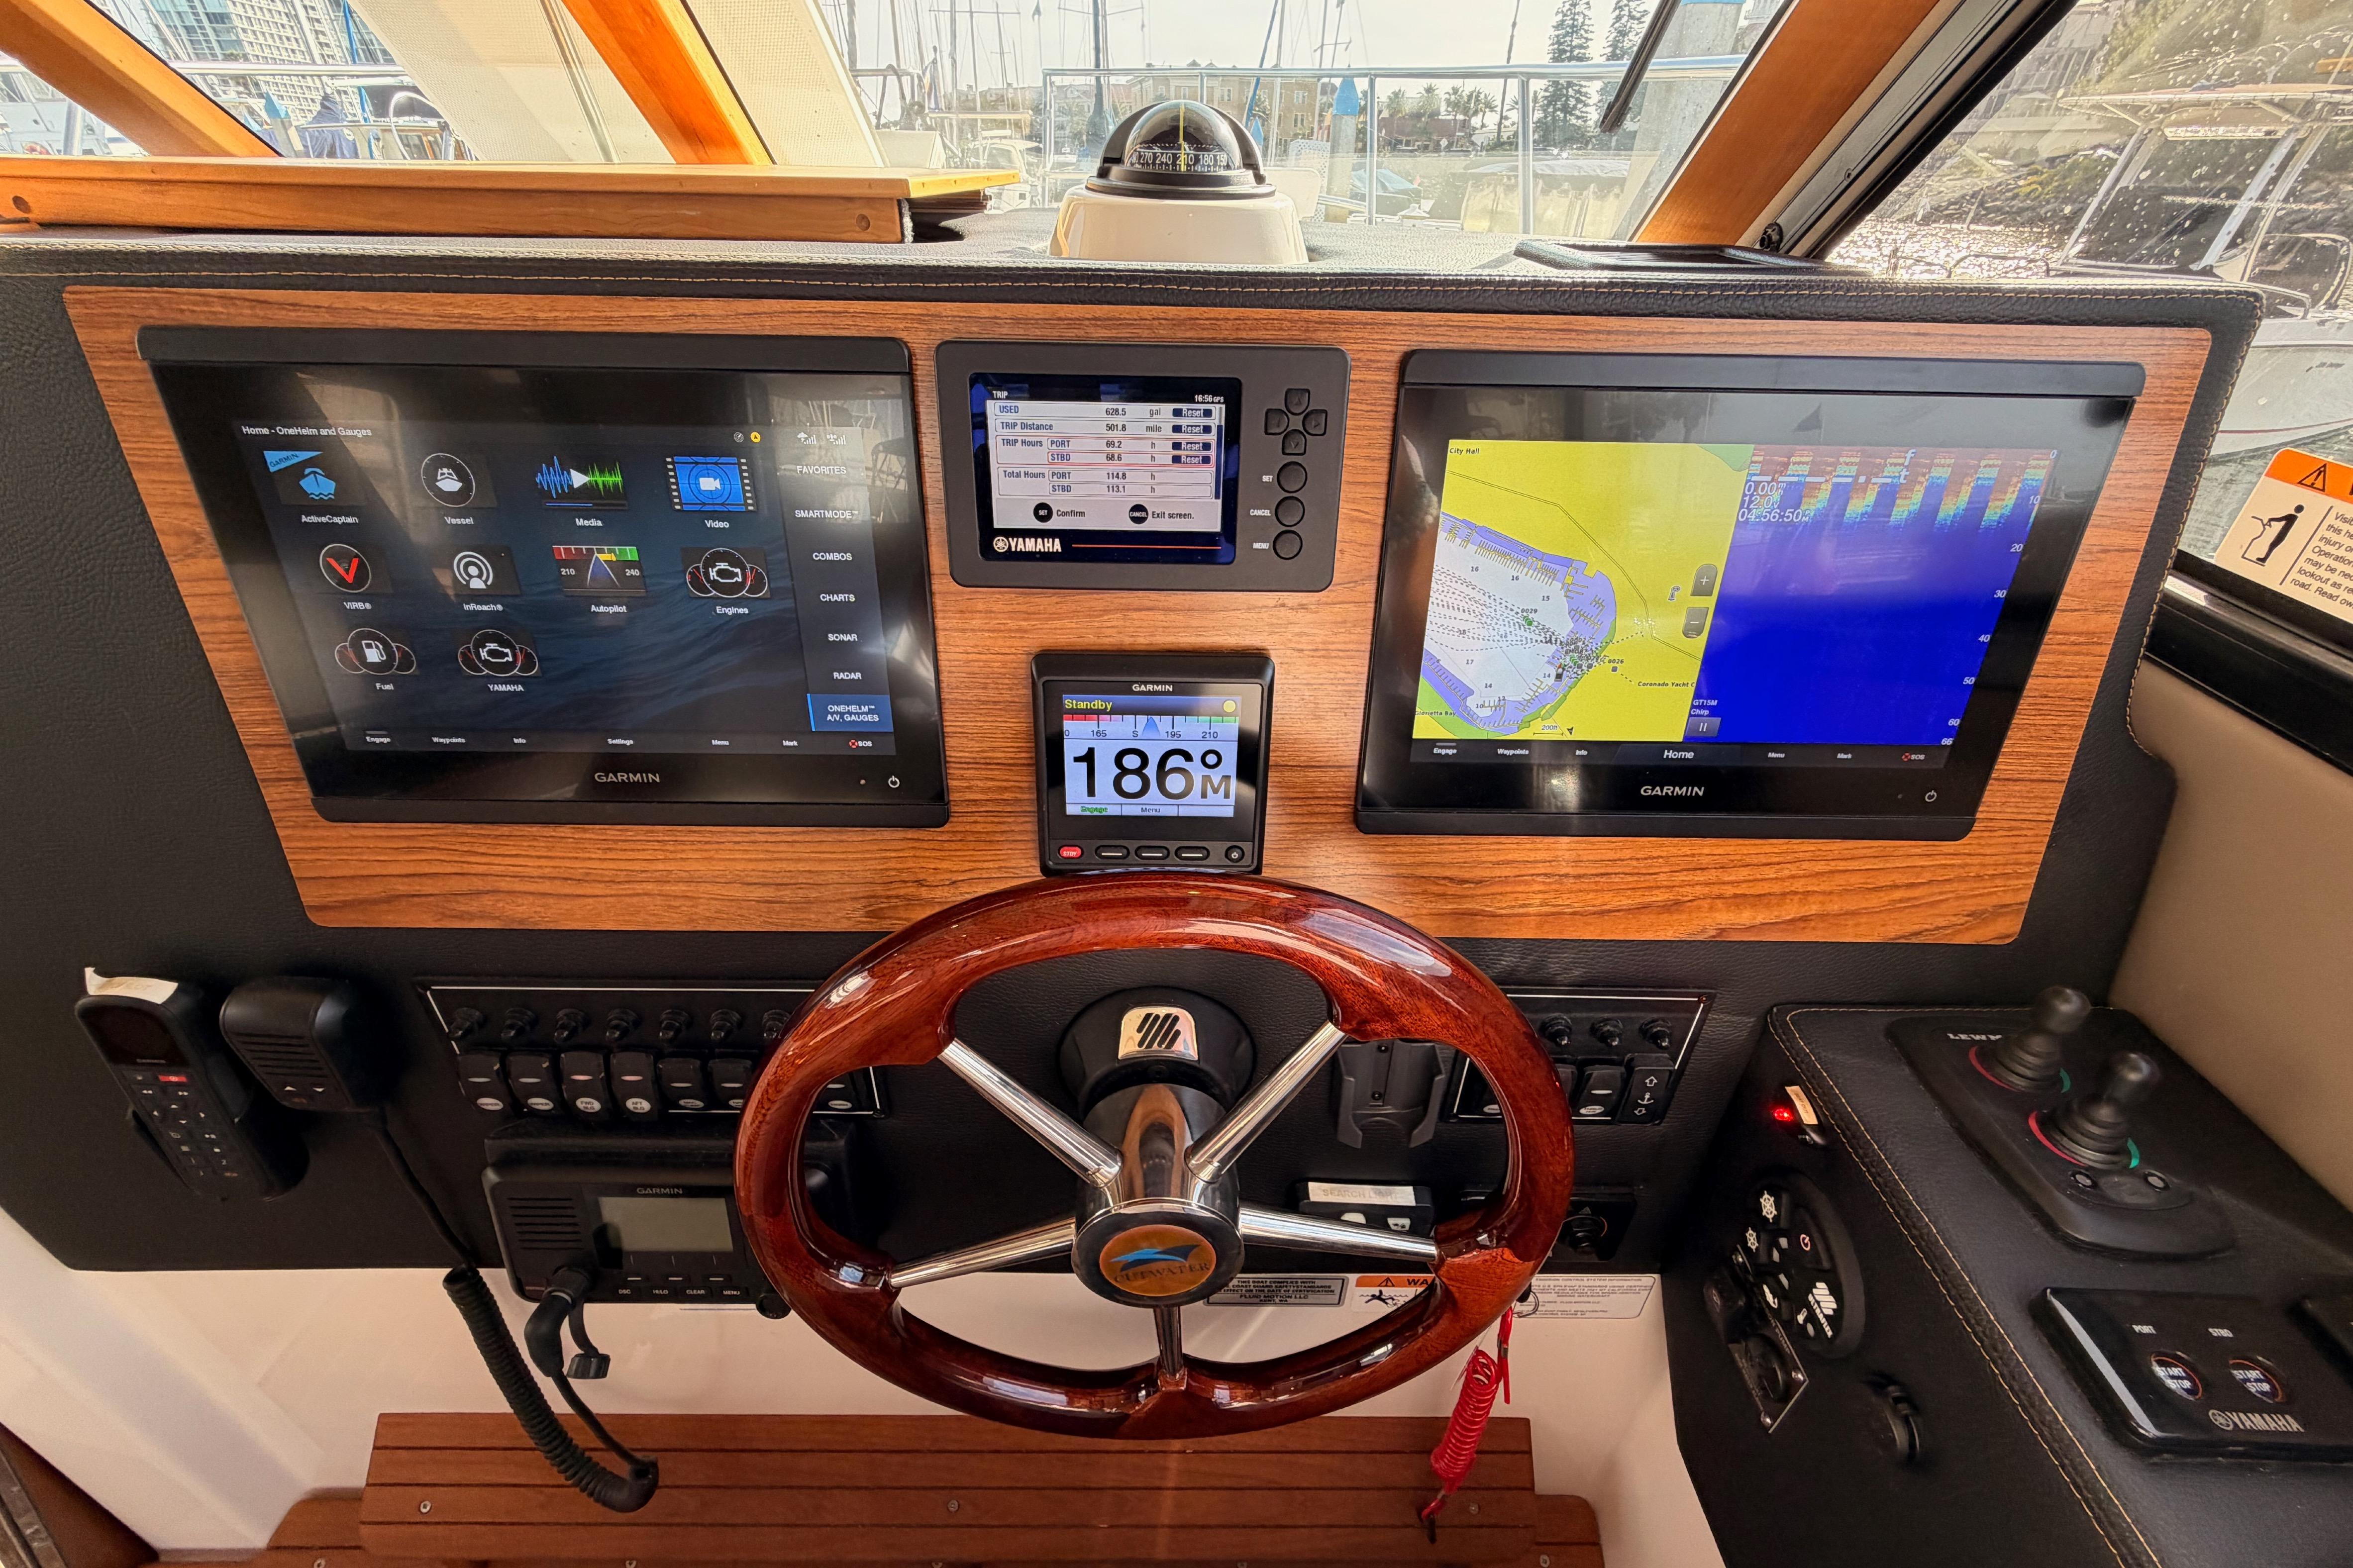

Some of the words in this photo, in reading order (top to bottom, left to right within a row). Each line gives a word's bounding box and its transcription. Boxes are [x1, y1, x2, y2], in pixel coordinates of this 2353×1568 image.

[1140, 153, 1152, 163] 270
[1156, 153, 1172, 164] 240
[1176, 154, 1194, 165] 210
[1199, 155, 1214, 165] 180
[1217, 155, 1227, 166] 150
[999, 405, 1019, 414] USED
[1105, 408, 1126, 416] 628.5
[1149, 408, 1161, 417] gal
[1182, 409, 1204, 417] Reset
[242, 426, 270, 435] Home
[276, 426, 318, 435] OneHelm
[337, 428, 372, 438] Gauges
[1019, 422, 1053, 431] Distance
[1106, 424, 1126, 432] 501.8
[1145, 424, 1162, 433] mile
[1182, 425, 1203, 434] Reset
[1021, 439, 1043, 447] Hours
[1106, 440, 1122, 449] 69.2
[269, 453, 299, 468] GARMIN
[1106, 454, 1122, 462] 68.6
[797, 466, 846, 475] FAVORITES
[2029, 495, 2040, 504] 10
[1056, 509, 1086, 518] Confirm
[301, 514, 358, 525] ActiveCaptain
[2326, 524, 2343, 535] this
[1009, 538, 1062, 552] YAMAHA
[2318, 534, 2345, 550] injury
[2010, 544, 2023, 552] 20
[2304, 558, 2325, 570] may
[2325, 564, 2337, 574] be
[2297, 567, 2330, 585] lookout
[2330, 581, 2343, 590] as
[2290, 579, 2312, 591] road.
[2314, 587, 2340, 601] Read
[591, 605, 627, 613] Autopilot
[716, 606, 748, 615] Engines
[1065, 699, 1112, 711] Standby
[1663, 750, 1694, 759] Home
[594, 773, 660, 783] GARMIN
[1640, 785, 1704, 796] GARMIN
[1808, 1293, 1833, 1338] ULTRAFLEX
[2132, 1325, 2156, 1334] PORT
[2208, 1328, 2234, 1337] STBD
[2156, 1367, 2185, 1376] START
[2234, 1371, 2265, 1379] START
[2168, 1379, 2192, 1389] STOP
[2248, 1382, 2272, 1392] STOP
[2226, 1411, 2304, 1433] YAMAHA
